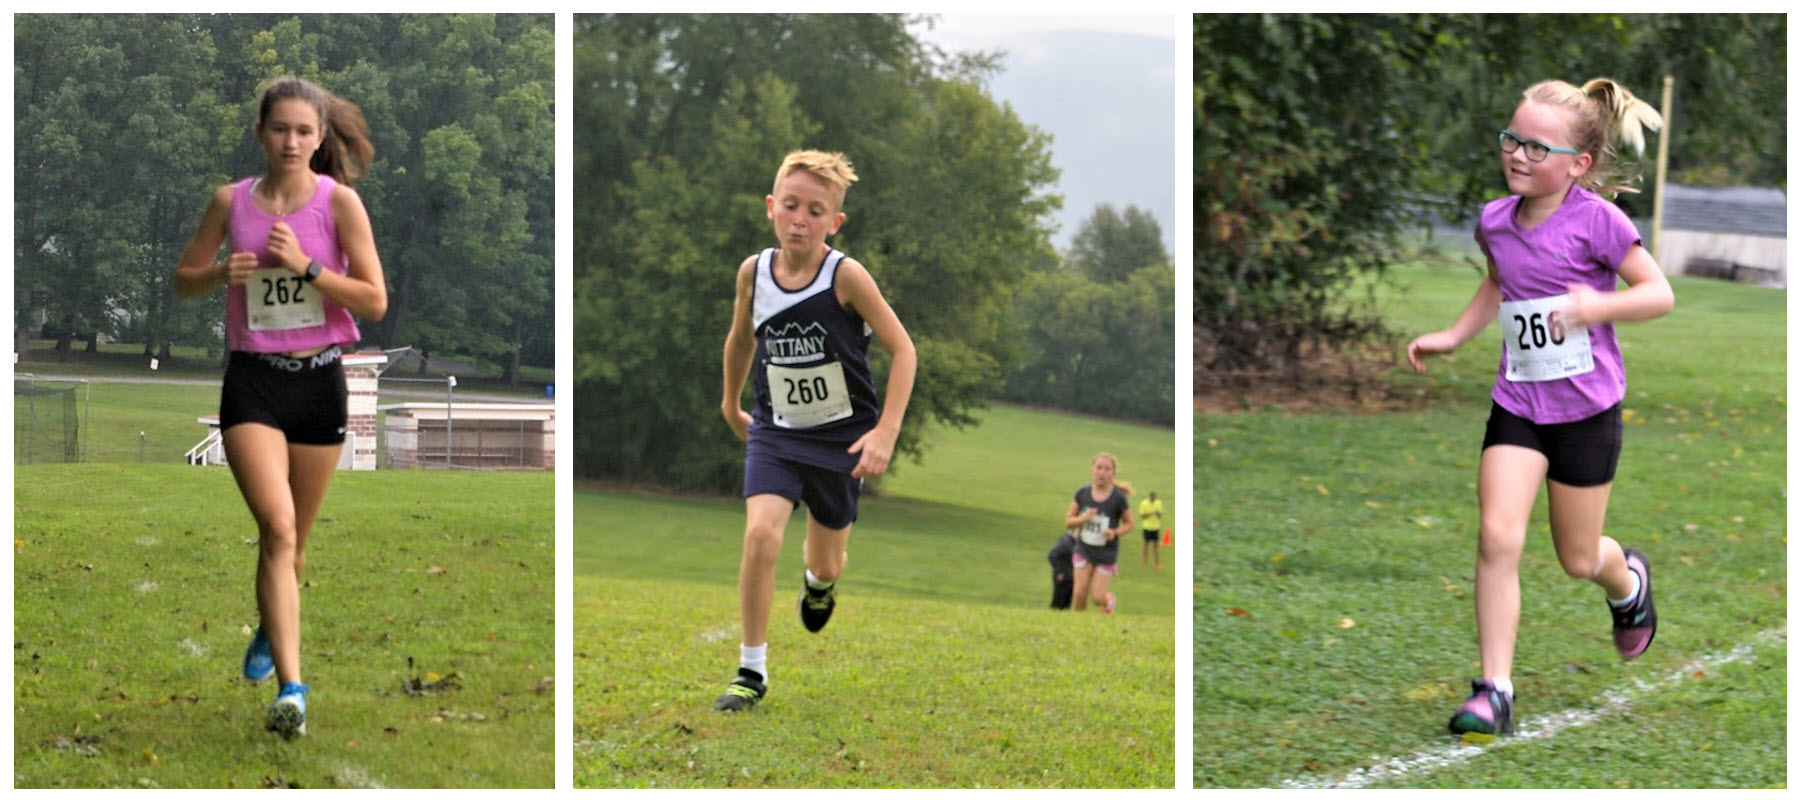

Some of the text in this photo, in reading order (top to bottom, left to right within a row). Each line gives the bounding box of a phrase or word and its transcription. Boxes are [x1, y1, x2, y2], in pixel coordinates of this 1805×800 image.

[262, 276, 305, 306] 262
[1513, 311, 1566, 350] 266
[783, 376, 828, 405] 260
